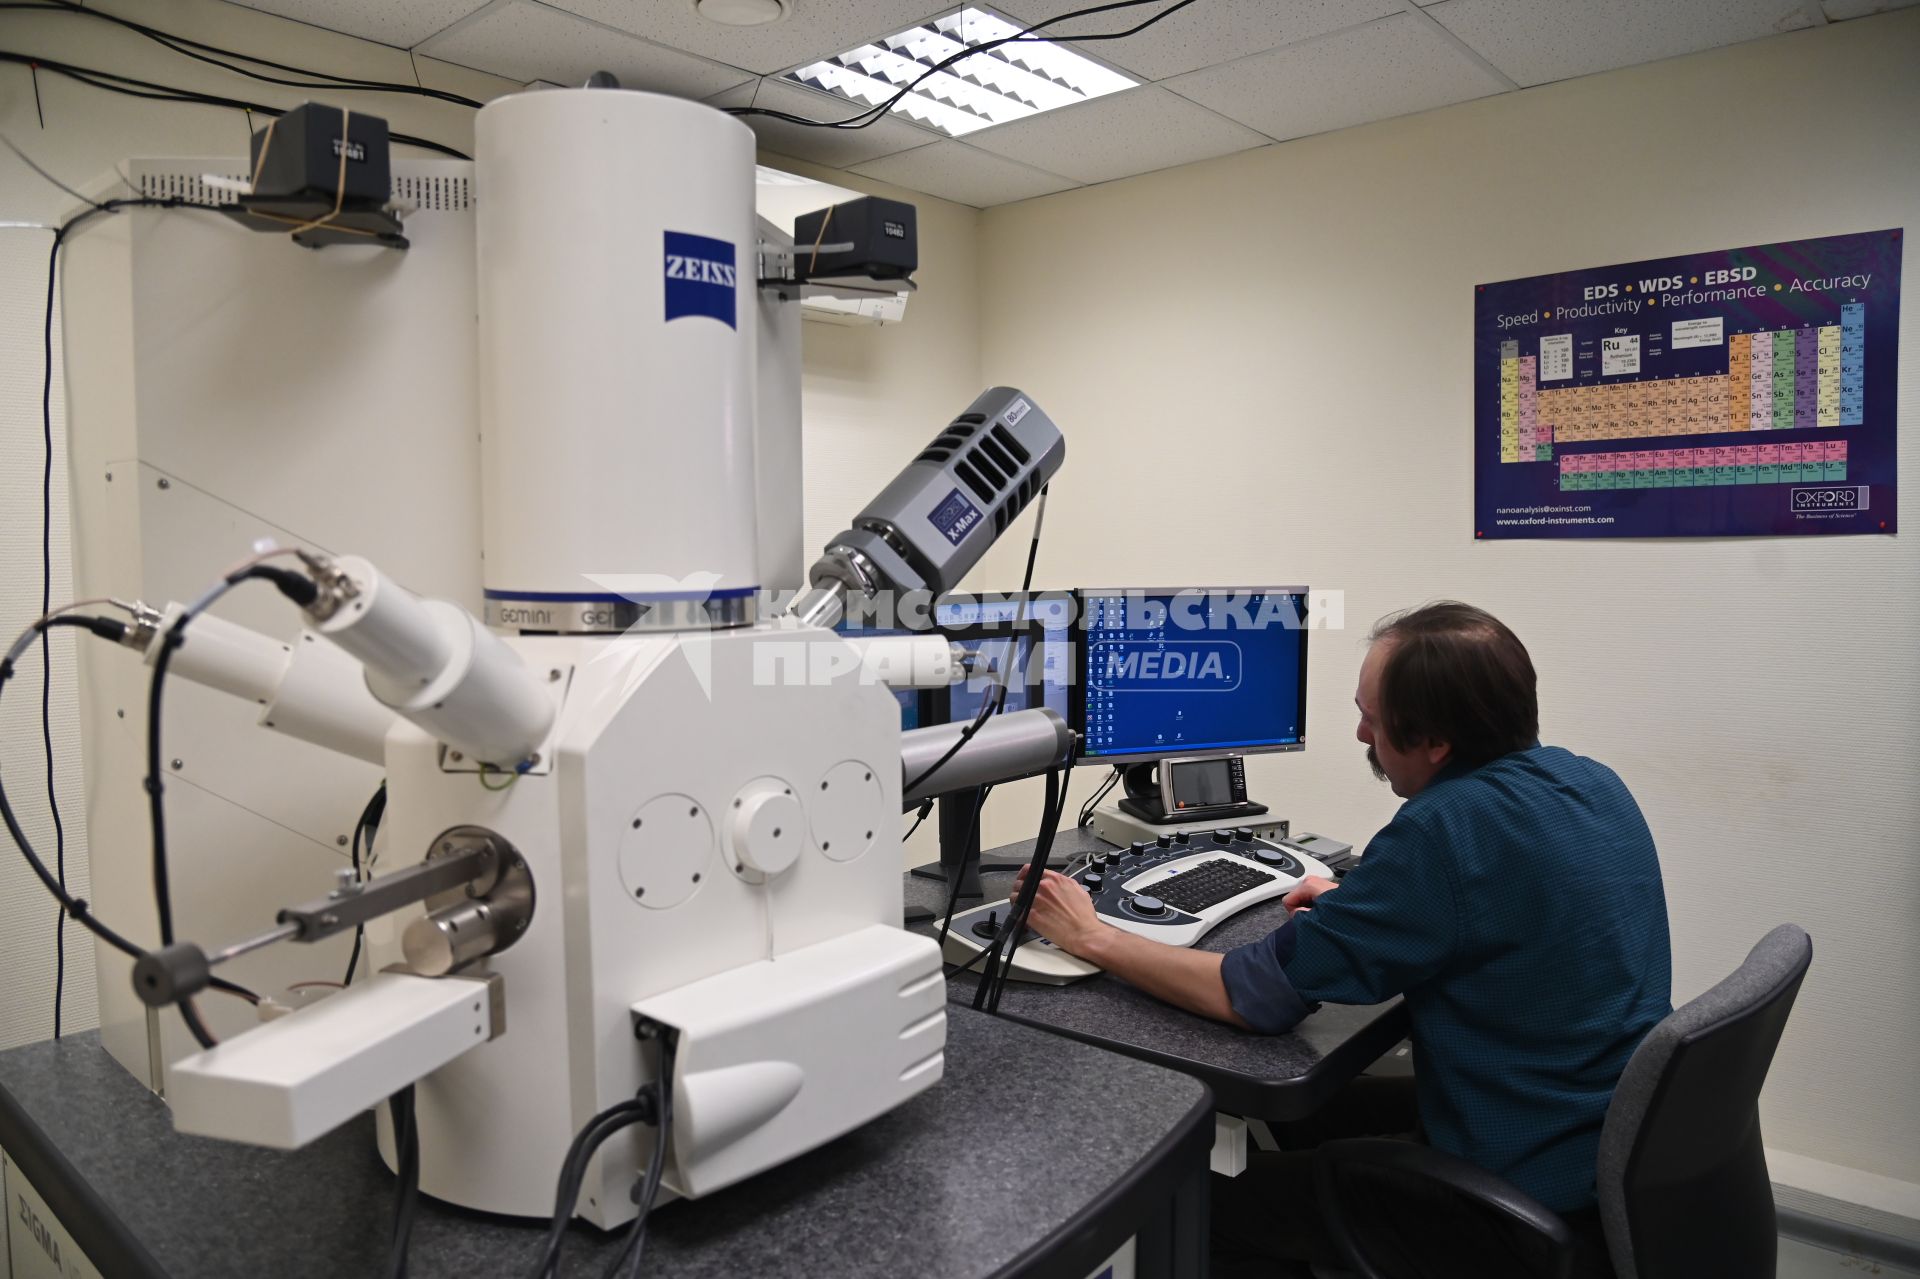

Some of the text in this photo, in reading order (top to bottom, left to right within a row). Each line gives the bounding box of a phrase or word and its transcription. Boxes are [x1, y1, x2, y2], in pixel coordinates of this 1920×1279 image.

[666, 255, 735, 288] ZEISS
[1584, 266, 1757, 300] EDS WDS EBSD
[1497, 274, 1871, 330] Speed Productivity Performance Accuracy
[1615, 327, 1628, 335] Key
[1603, 340, 1620, 351] Ru
[1796, 490, 1855, 503] OXFORD
[1496, 505, 1591, 514] nanoanalysis@oxinst.com
[946, 509, 978, 541] X-Max
[1496, 516, 1614, 526] www.oxford-instruments.com
